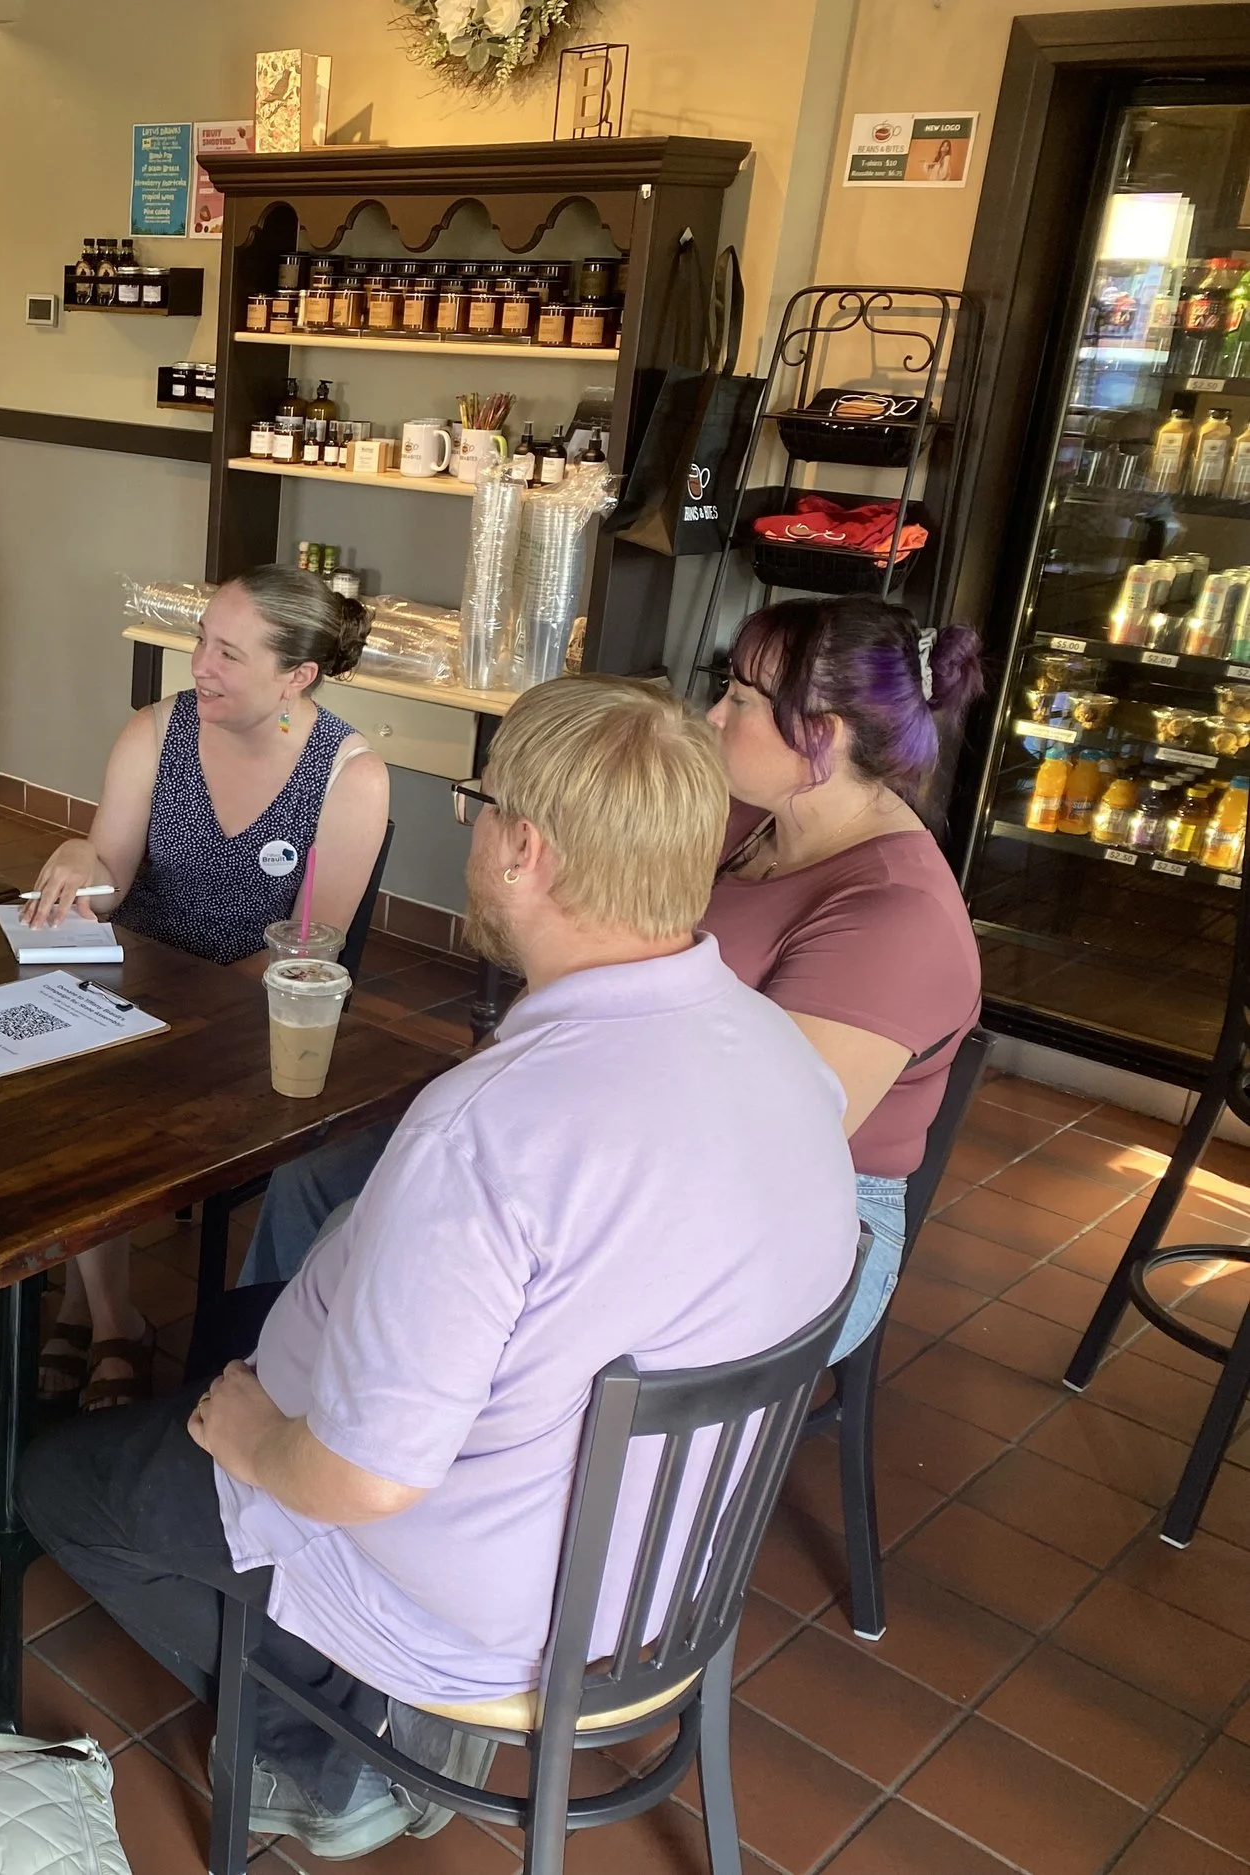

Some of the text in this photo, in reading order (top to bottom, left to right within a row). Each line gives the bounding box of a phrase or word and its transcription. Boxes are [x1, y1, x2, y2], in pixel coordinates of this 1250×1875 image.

[941, 124, 961, 132] LOGO
[202, 129, 222, 138] FRUIT
[202, 138, 236, 146] SMOOTHIES
[857, 145, 879, 153] BEANS
[885, 145, 905, 153] BITES
[1057, 640, 1080, 651] $5.00
[1109, 851, 1133, 863] $2.50
[1157, 862, 1182, 874] $2.50
